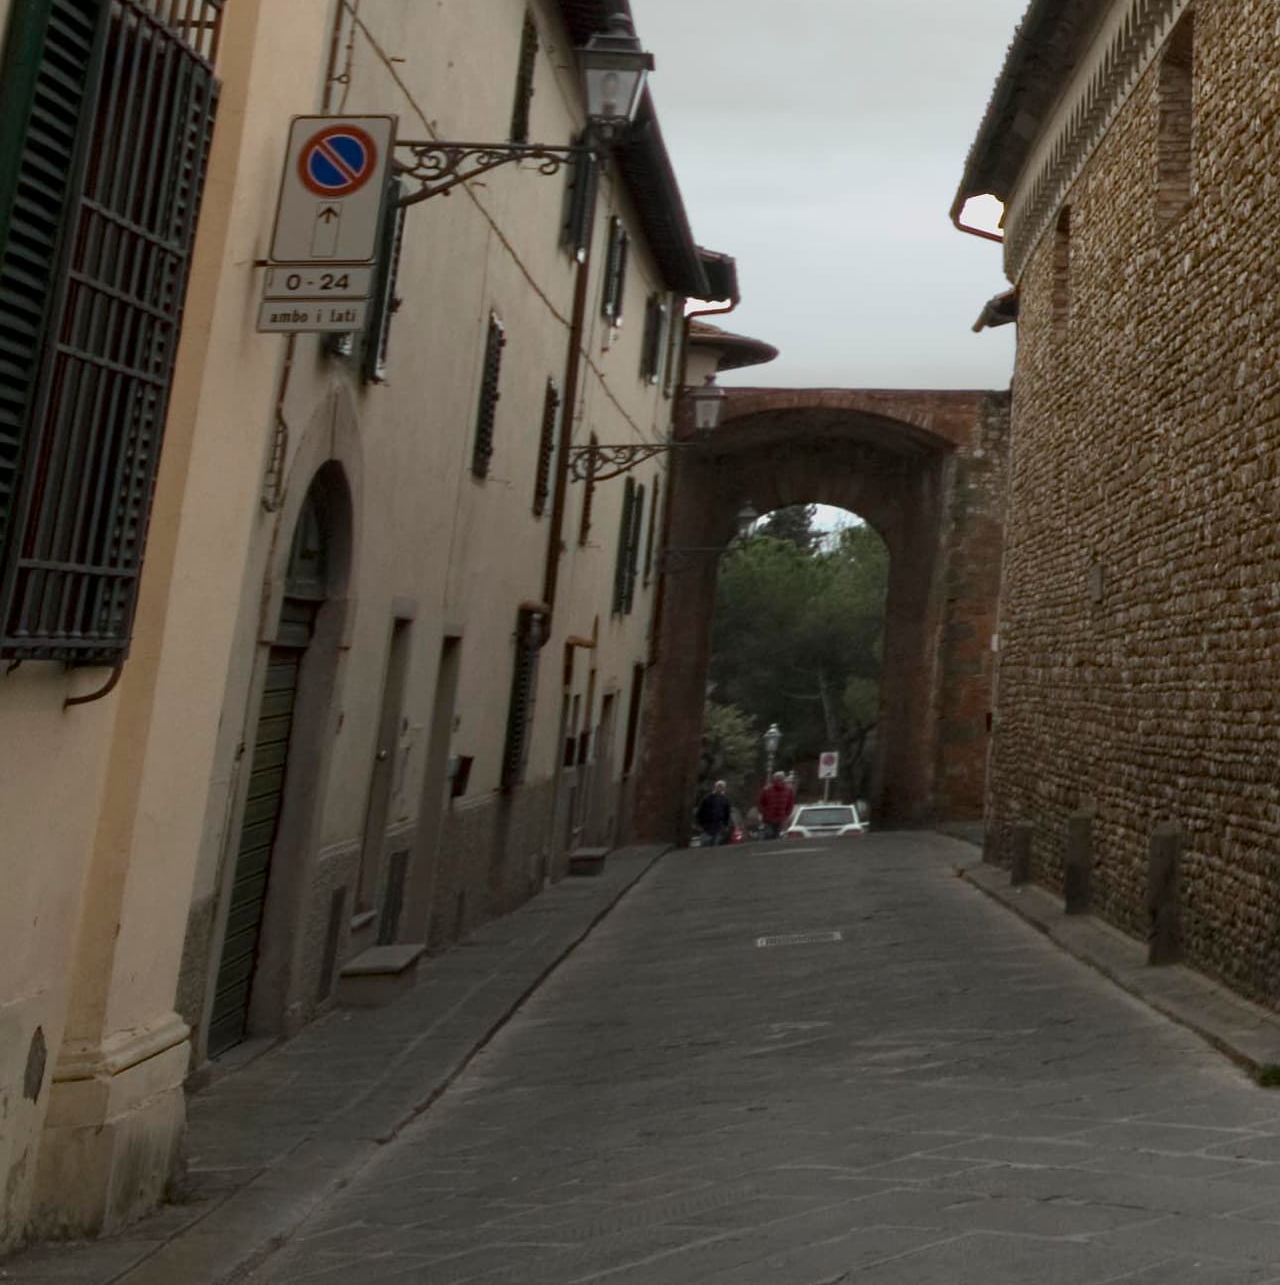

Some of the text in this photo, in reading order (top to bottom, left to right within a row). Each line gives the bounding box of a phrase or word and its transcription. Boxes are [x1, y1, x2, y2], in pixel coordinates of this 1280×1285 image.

[285, 273, 301, 291] 0
[319, 273, 350, 291] 24
[270, 308, 357, 324] ambo i lati
